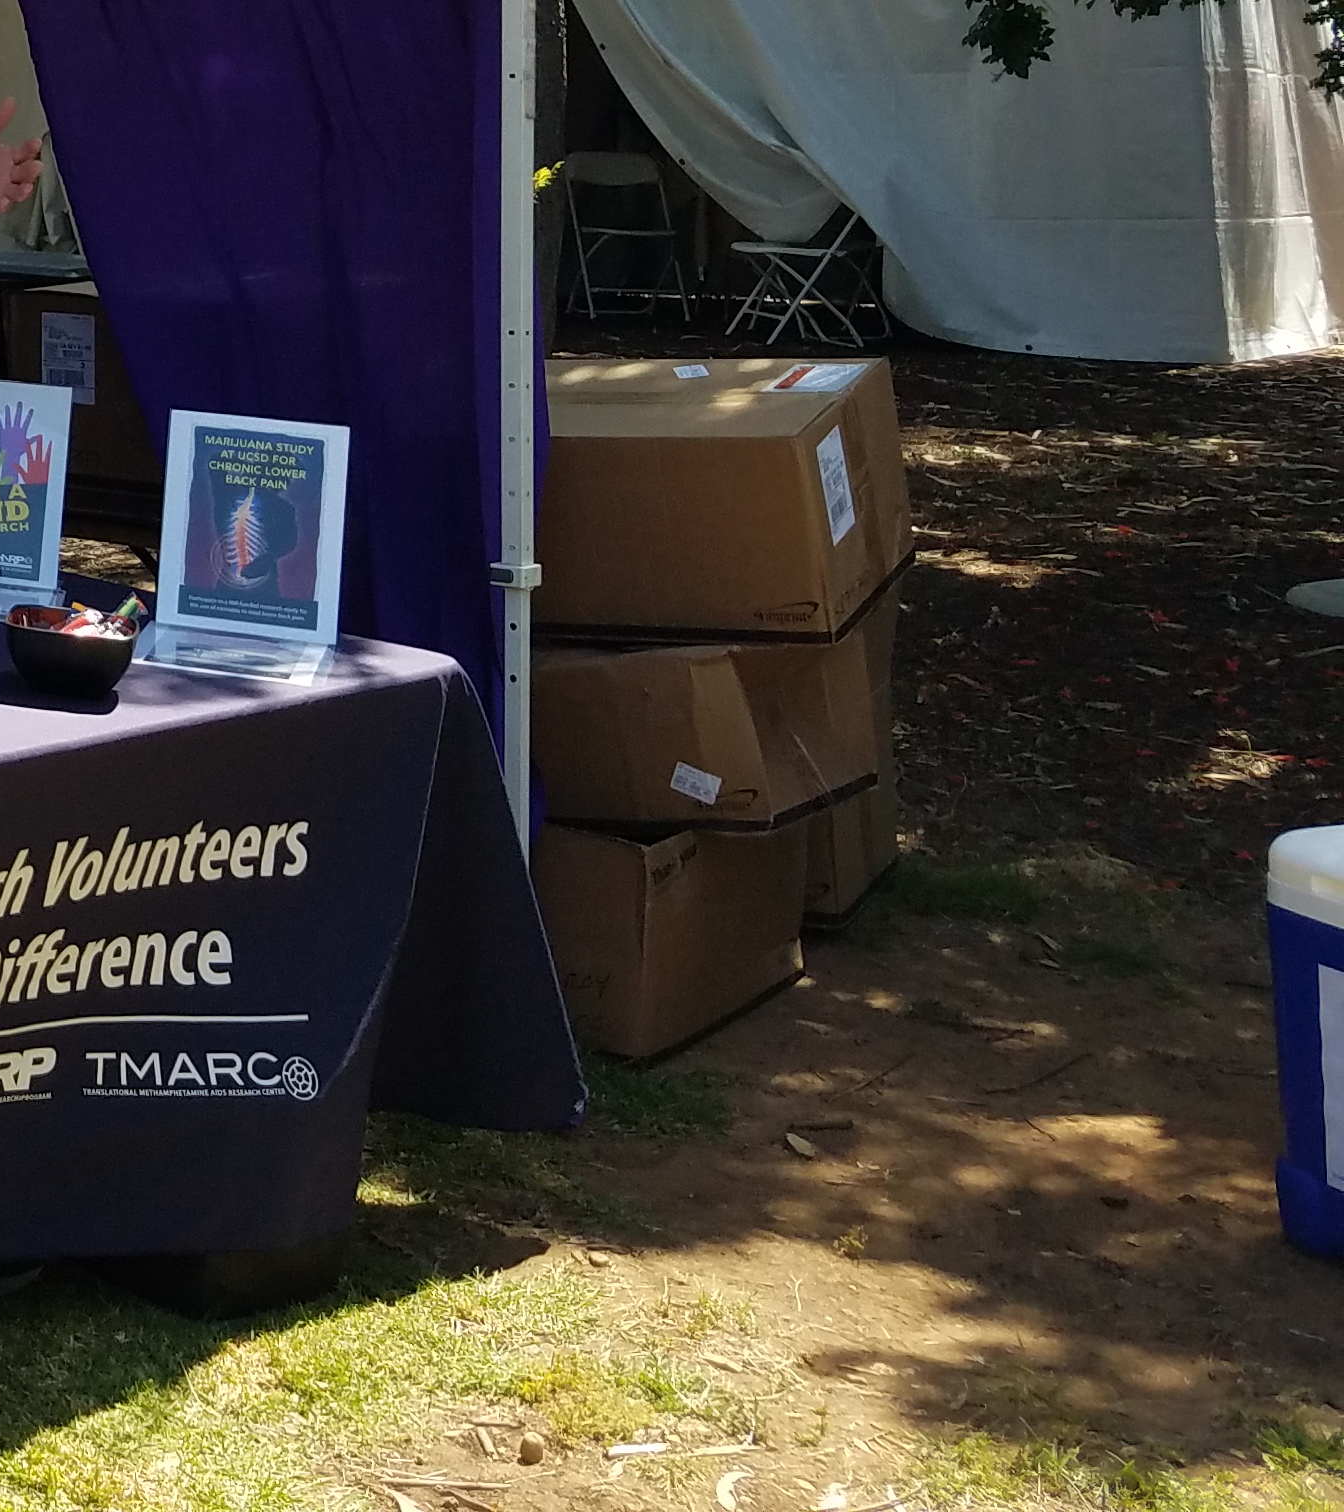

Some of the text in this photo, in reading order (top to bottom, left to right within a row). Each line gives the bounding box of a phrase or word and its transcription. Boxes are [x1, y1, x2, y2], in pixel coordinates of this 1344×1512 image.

[205, 435, 314, 455] MARIJUANA STUDY
[220, 449, 296, 466] AT UCSD FOR
[208, 461, 306, 480] CHRONIC LOWER
[9, 484, 27, 499] A
[225, 475, 287, 490] BACK PAIN
[42, 819, 310, 909] Volunteers
[85, 1051, 282, 1087] TMARC
